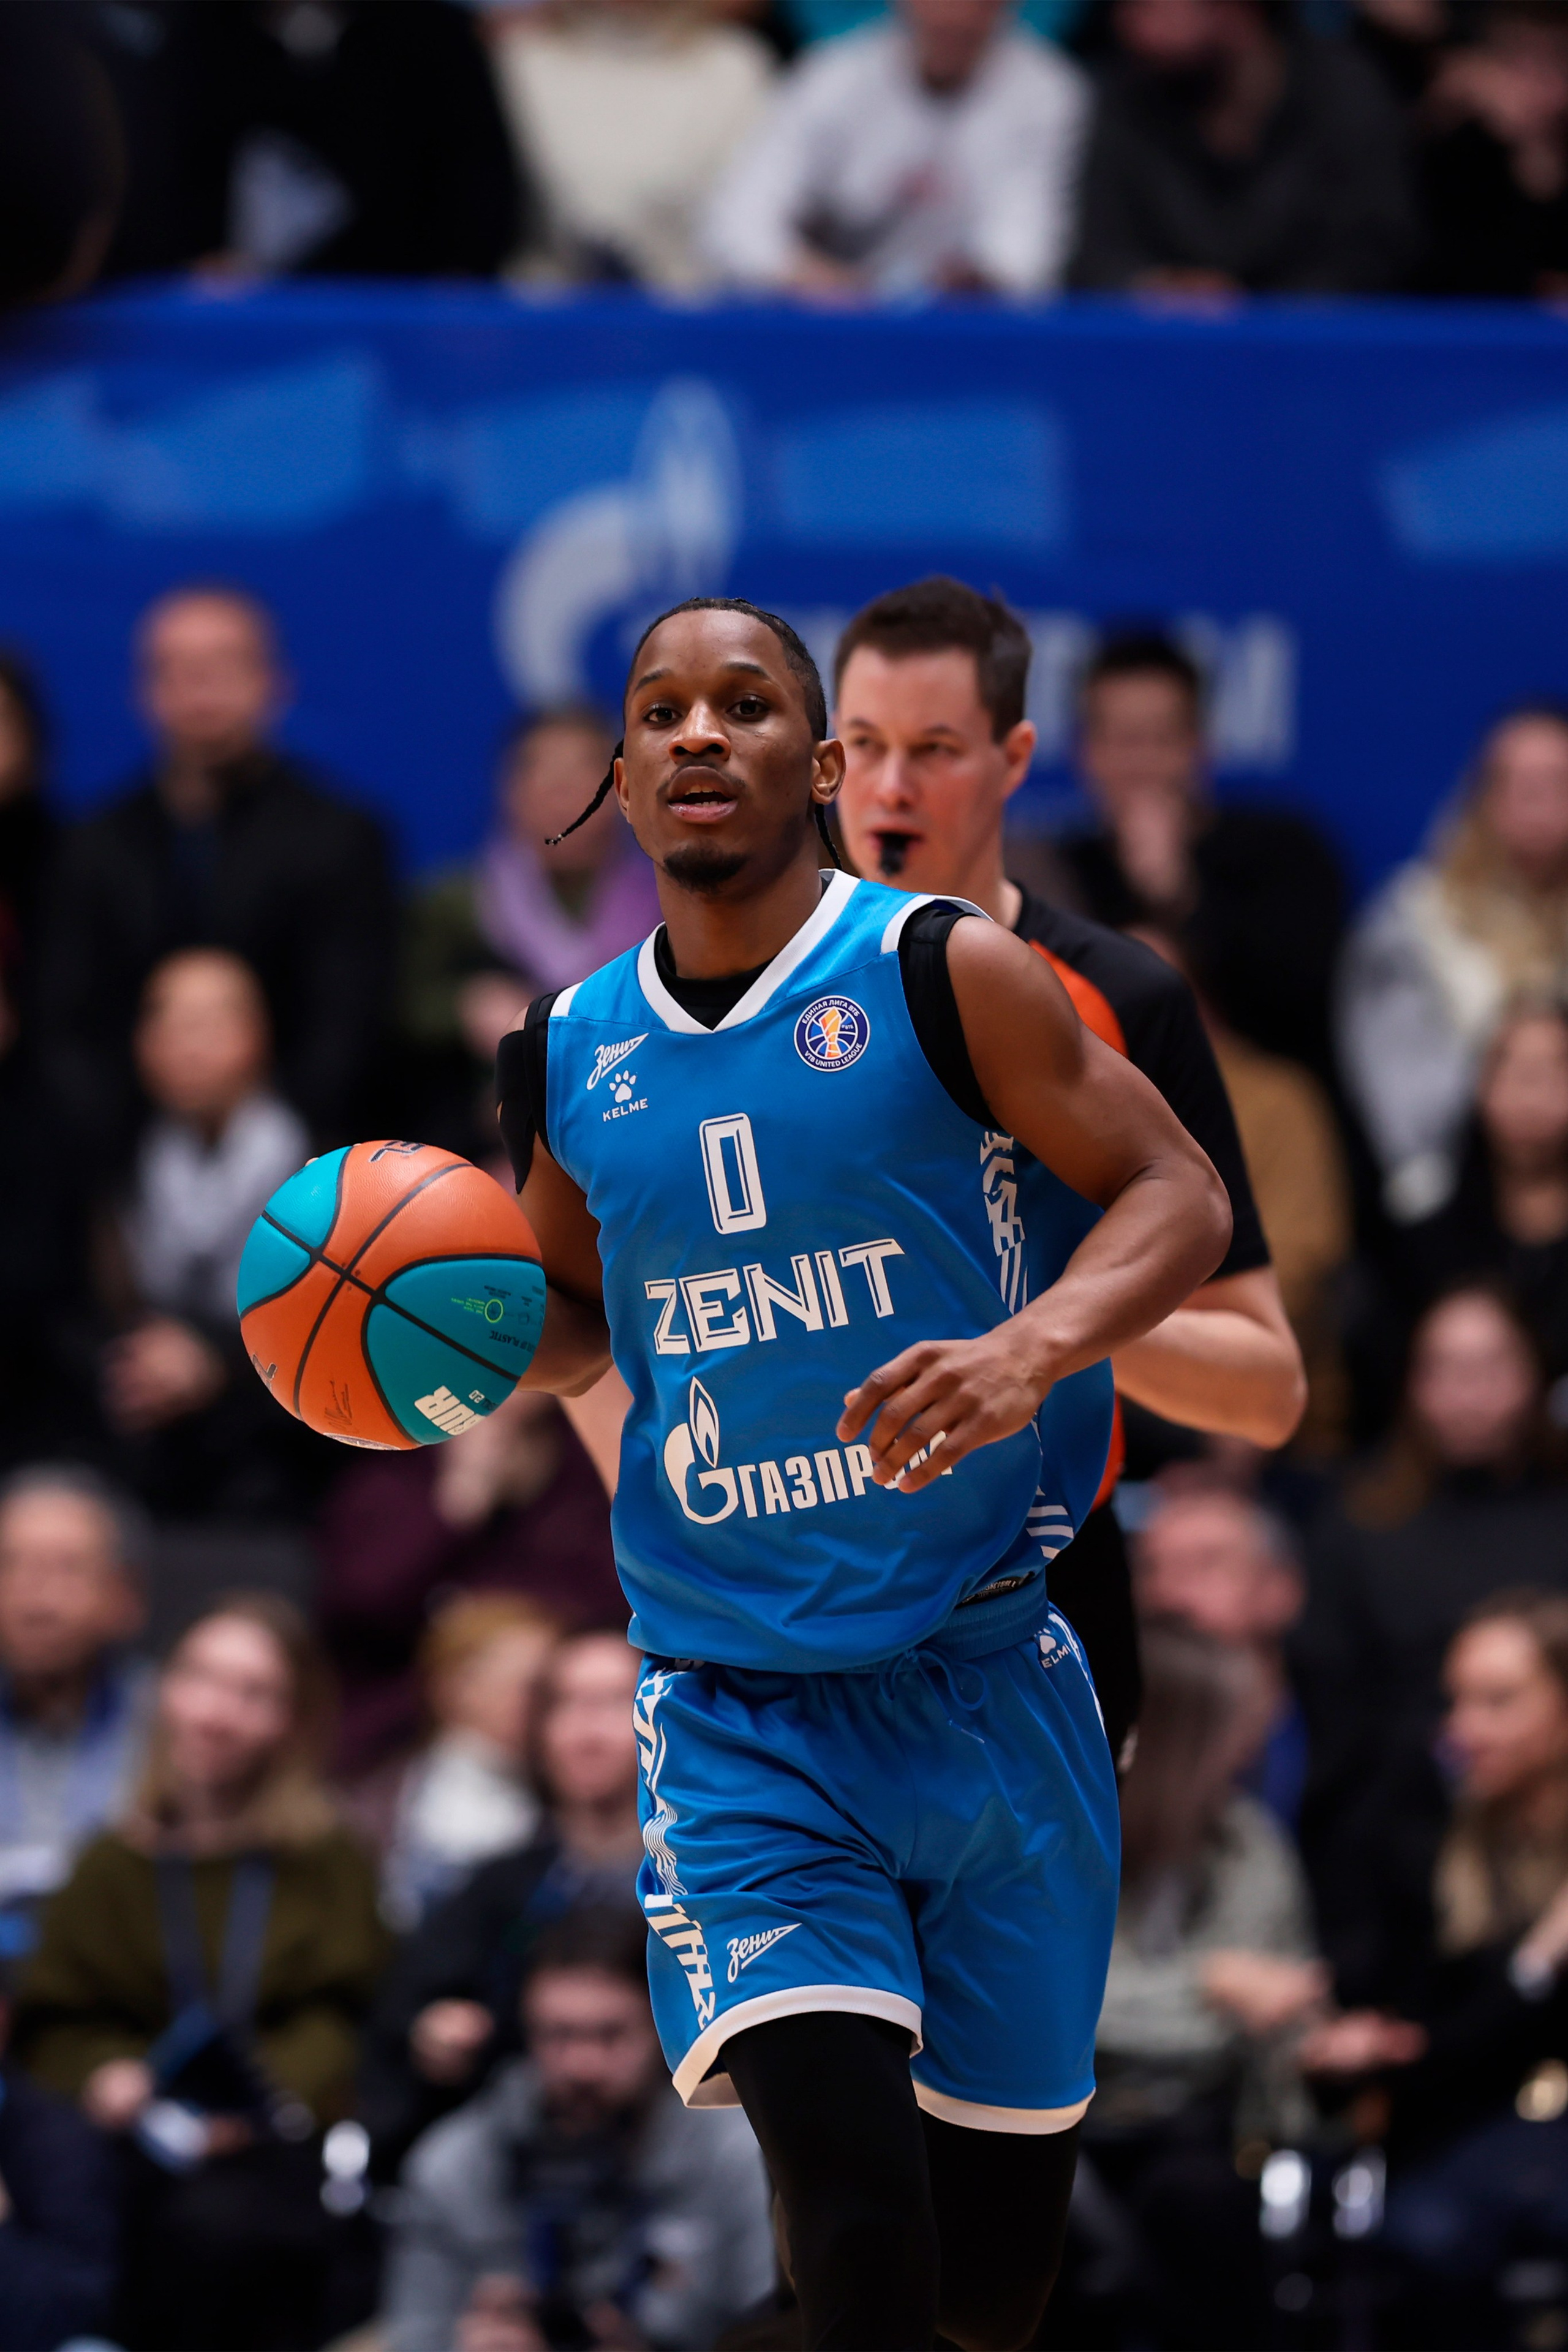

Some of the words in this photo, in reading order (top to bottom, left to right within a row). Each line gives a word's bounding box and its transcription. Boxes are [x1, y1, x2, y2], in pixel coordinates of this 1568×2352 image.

[802, 1001, 827, 1024] ЕДИНАЯ
[828, 1000, 848, 1008] ЛИГА
[848, 1005, 861, 1017] ВТБ
[804, 1050, 815, 1063] VTB
[841, 1042, 862, 1065] LEAGUE
[603, 1098, 649, 1122] KELME
[699, 1112, 767, 1235] 0
[644, 1238, 905, 1355] ZENIT
[414, 1385, 486, 1436] BUR
[737, 1430, 953, 1518] ГАЗПР
[1041, 1643, 1071, 1668] ELM
